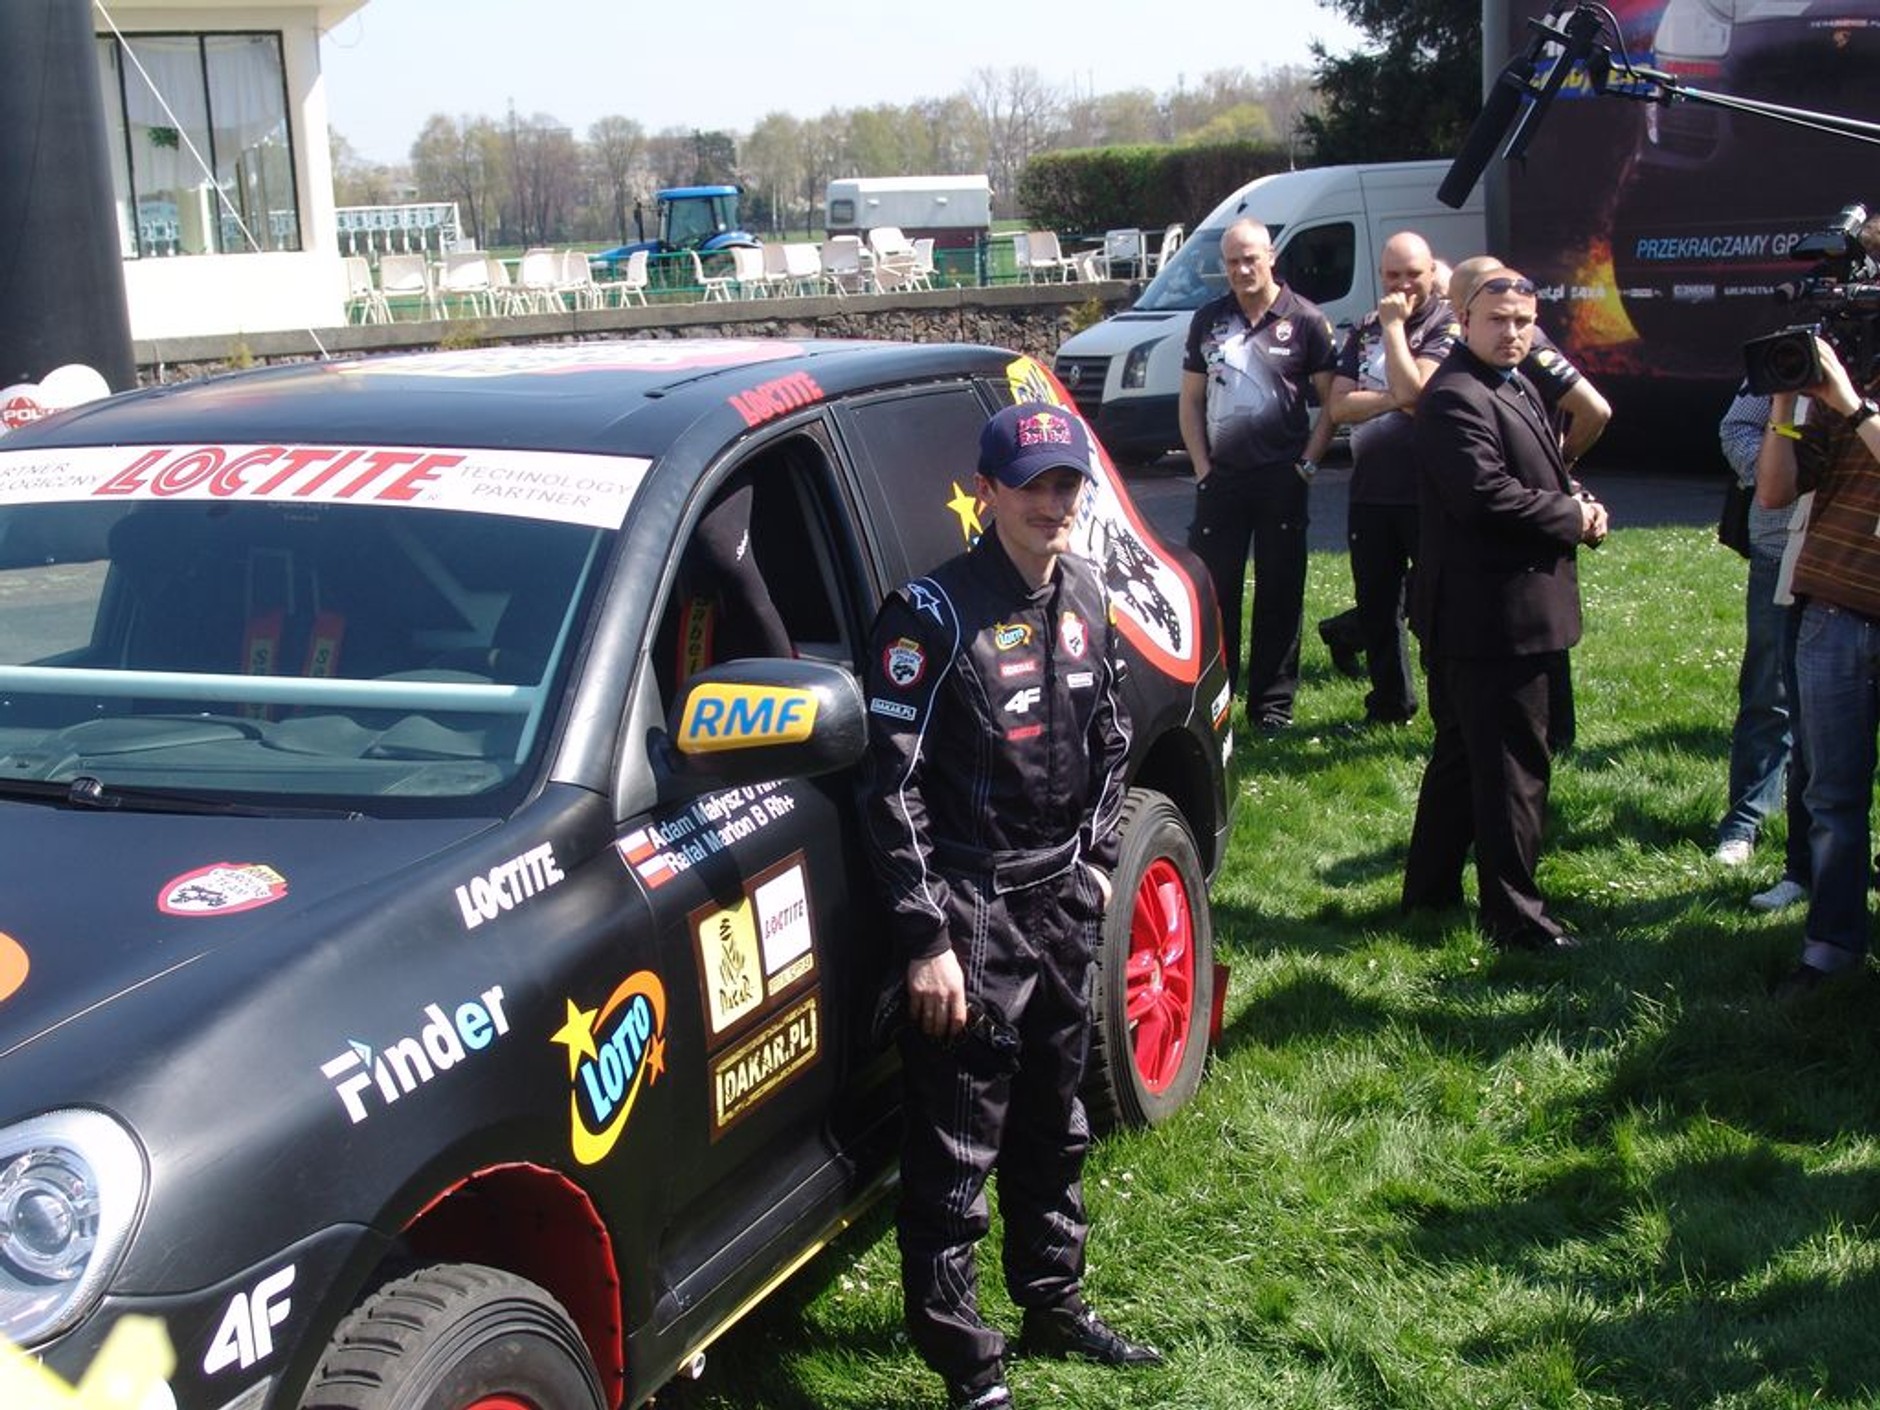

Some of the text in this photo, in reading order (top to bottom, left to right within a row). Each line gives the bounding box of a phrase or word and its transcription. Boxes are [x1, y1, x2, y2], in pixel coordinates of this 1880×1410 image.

[1635, 234, 1769, 258] PRZEKRACZAMY
[727, 370, 824, 427] LOCTITE
[91, 447, 467, 500] LOCTITE
[460, 466, 632, 494] TECHNOLOGY
[472, 483, 591, 507] PARTNER
[689, 697, 807, 738] RMF
[1004, 687, 1041, 713] 4F
[647, 816, 695, 849] Adam
[701, 815, 757, 853] Marton
[749, 804, 769, 827] B
[455, 841, 563, 929] LOCTITE
[765, 899, 804, 939] LOCTITE
[320, 985, 510, 1124] Finder
[581, 995, 651, 1123] LOTTO
[724, 1018, 811, 1106] DAKAR.PL
[203, 1263, 296, 1375] 4F
